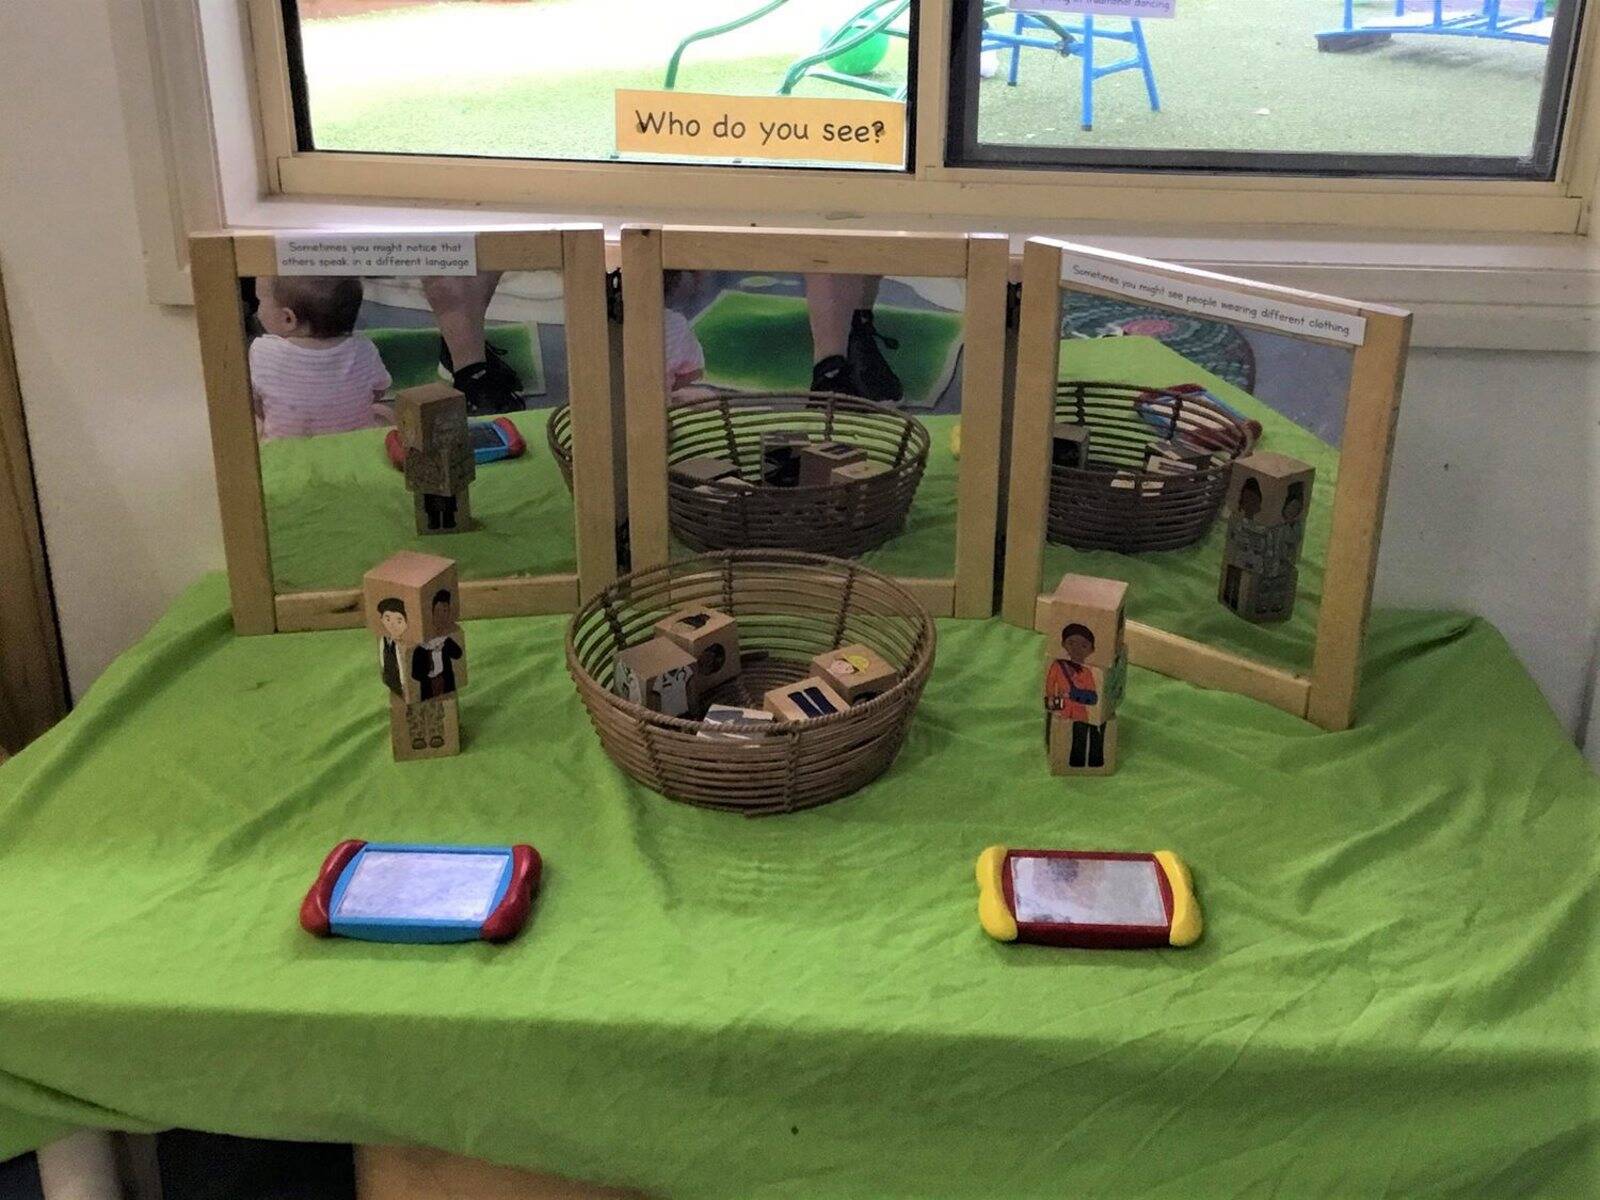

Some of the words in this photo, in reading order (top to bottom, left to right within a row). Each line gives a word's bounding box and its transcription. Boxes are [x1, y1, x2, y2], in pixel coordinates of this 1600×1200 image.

[635, 109, 701, 137] Who
[713, 114, 746, 139] do
[759, 120, 810, 146] you
[822, 119, 886, 144] see?
[288, 242, 347, 253] Sometimes
[351, 245, 369, 254] you
[373, 243, 402, 255] might
[406, 244, 437, 252] notice
[441, 243, 462, 252] that
[282, 256, 316, 266] others
[319, 257, 346, 267] speak
[352, 258, 362, 266] in
[376, 256, 421, 266] different
[425, 257, 470, 270] language
[1072, 264, 1120, 286] Sometimes
[1121, 279, 1136, 290] you
[1139, 283, 1165, 297] might
[1168, 289, 1184, 301] see
[1186, 295, 1218, 308] people
[1221, 301, 1258, 317] wearing
[1261, 308, 1305, 326] different
[1308, 318, 1350, 337] clothing
